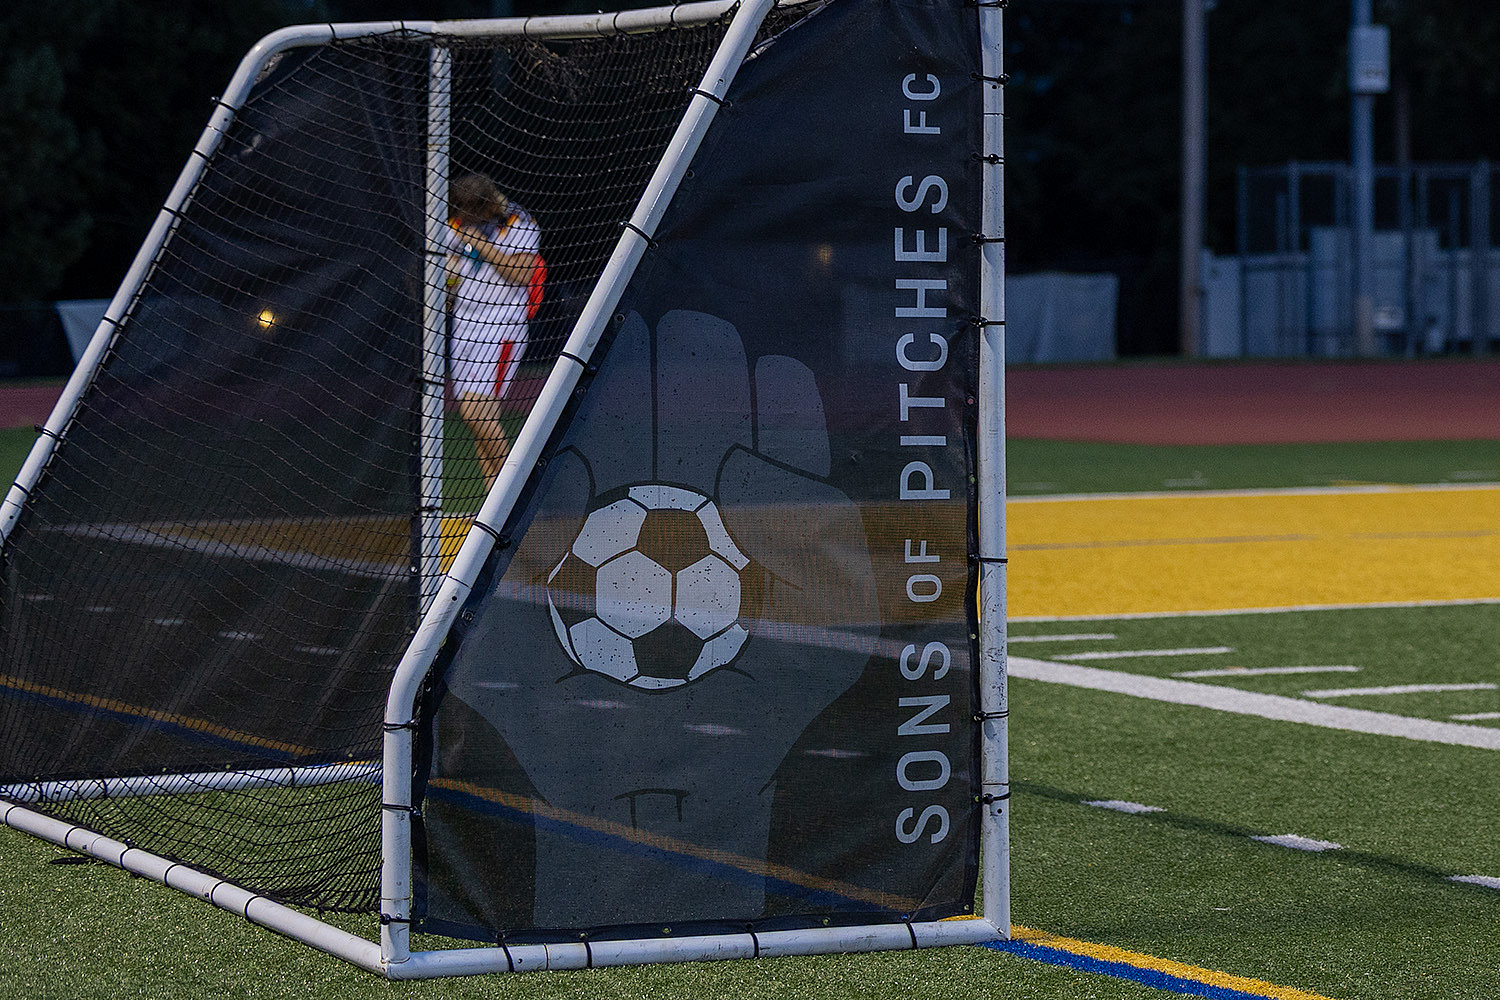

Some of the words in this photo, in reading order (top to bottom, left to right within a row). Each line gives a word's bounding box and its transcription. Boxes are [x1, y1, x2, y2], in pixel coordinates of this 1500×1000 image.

[902, 73, 941, 135] FC
[894, 175, 950, 500] PITCHES
[905, 539, 942, 602] OF
[895, 641, 951, 844] SONS
